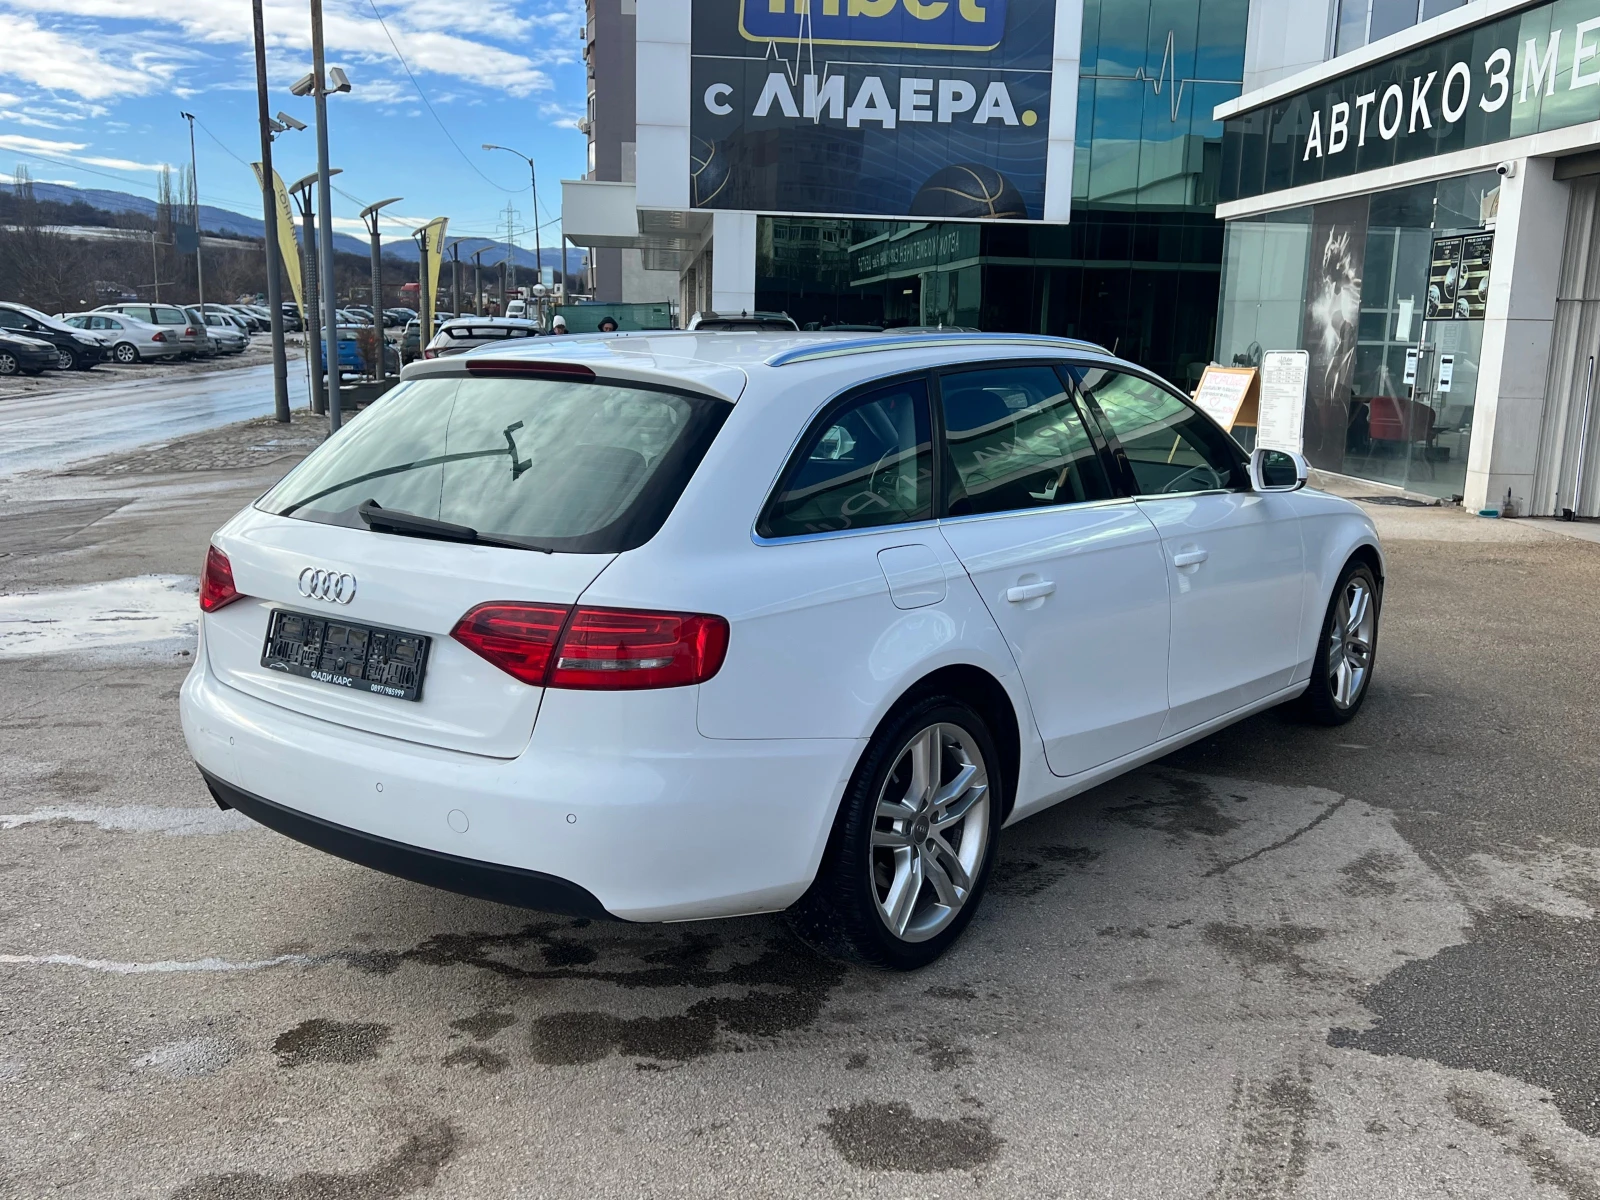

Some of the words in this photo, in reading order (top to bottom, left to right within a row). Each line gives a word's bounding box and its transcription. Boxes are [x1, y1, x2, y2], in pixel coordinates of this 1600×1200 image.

[752, 72, 1037, 129] ЛИДЕРА.
[311, 670, 332, 683] ФАДИ
[333, 674, 352, 686] КАРС
